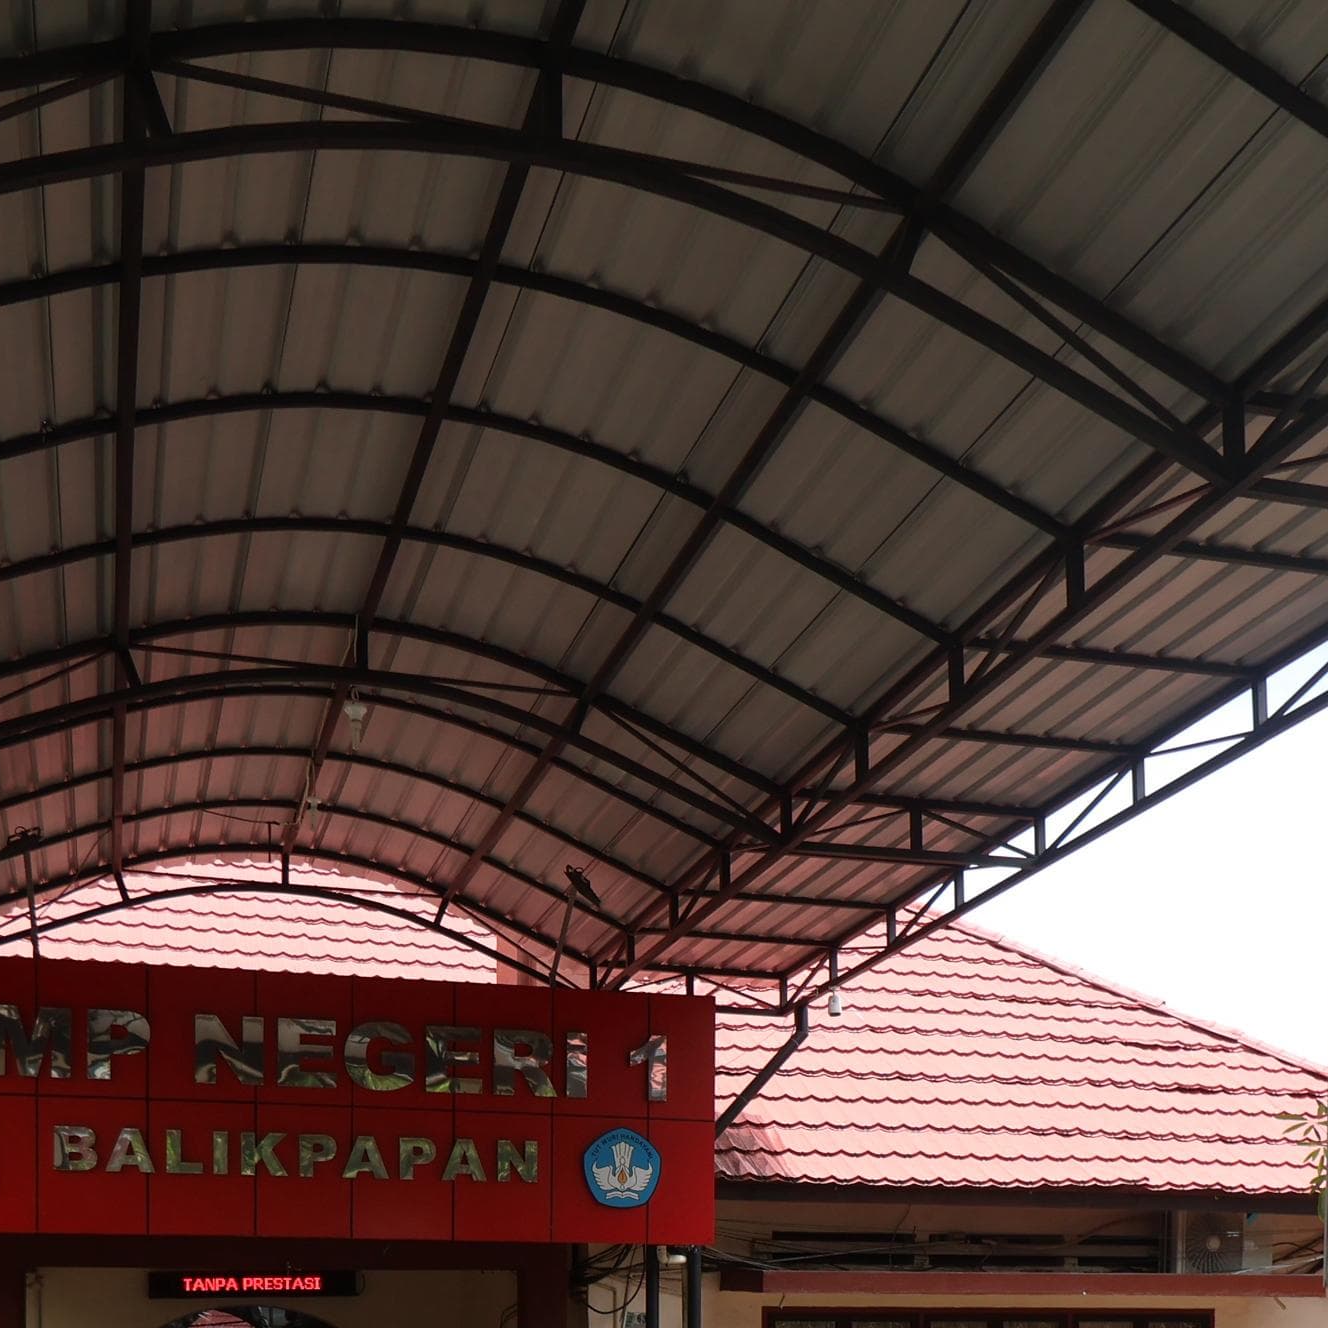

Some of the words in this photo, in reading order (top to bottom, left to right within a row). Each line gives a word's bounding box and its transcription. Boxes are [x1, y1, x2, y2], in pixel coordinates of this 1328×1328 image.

[194, 1014, 588, 1098] NEGERI
[629, 1035, 668, 1102] 1
[53, 1125, 539, 1183] BALIKPAPAN
[183, 1278, 238, 1291] TANPA
[242, 1277, 321, 1291] PRESTASI
